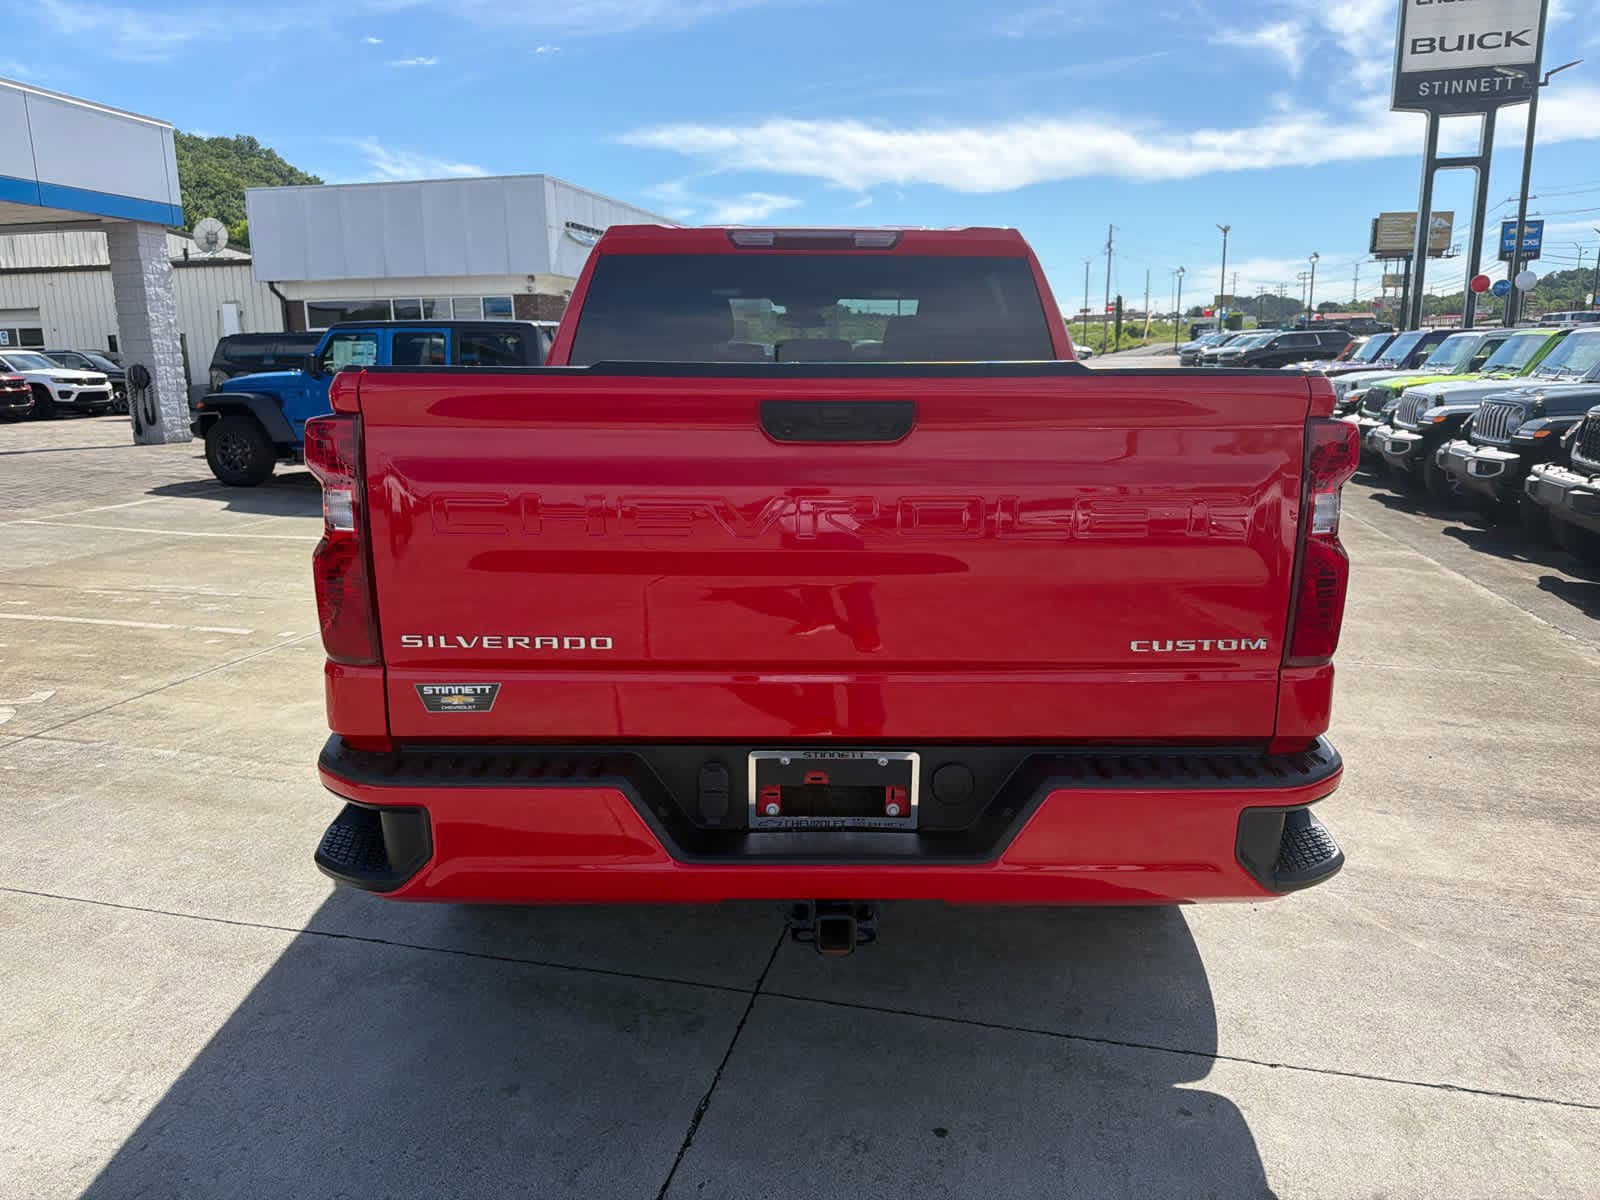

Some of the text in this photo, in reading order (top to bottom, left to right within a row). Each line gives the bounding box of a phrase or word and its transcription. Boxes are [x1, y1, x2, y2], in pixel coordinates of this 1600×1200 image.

[1410, 29, 1532, 55] BUICK
[1418, 76, 1514, 96] STINNETT
[1504, 239, 1540, 248] TRCKS
[432, 492, 1250, 540] CHEVROLET
[401, 634, 613, 650] SILVERADO
[1130, 638, 1268, 652] CUSTOM
[423, 685, 492, 695] STINNETT
[802, 751, 865, 760] STINNETT
